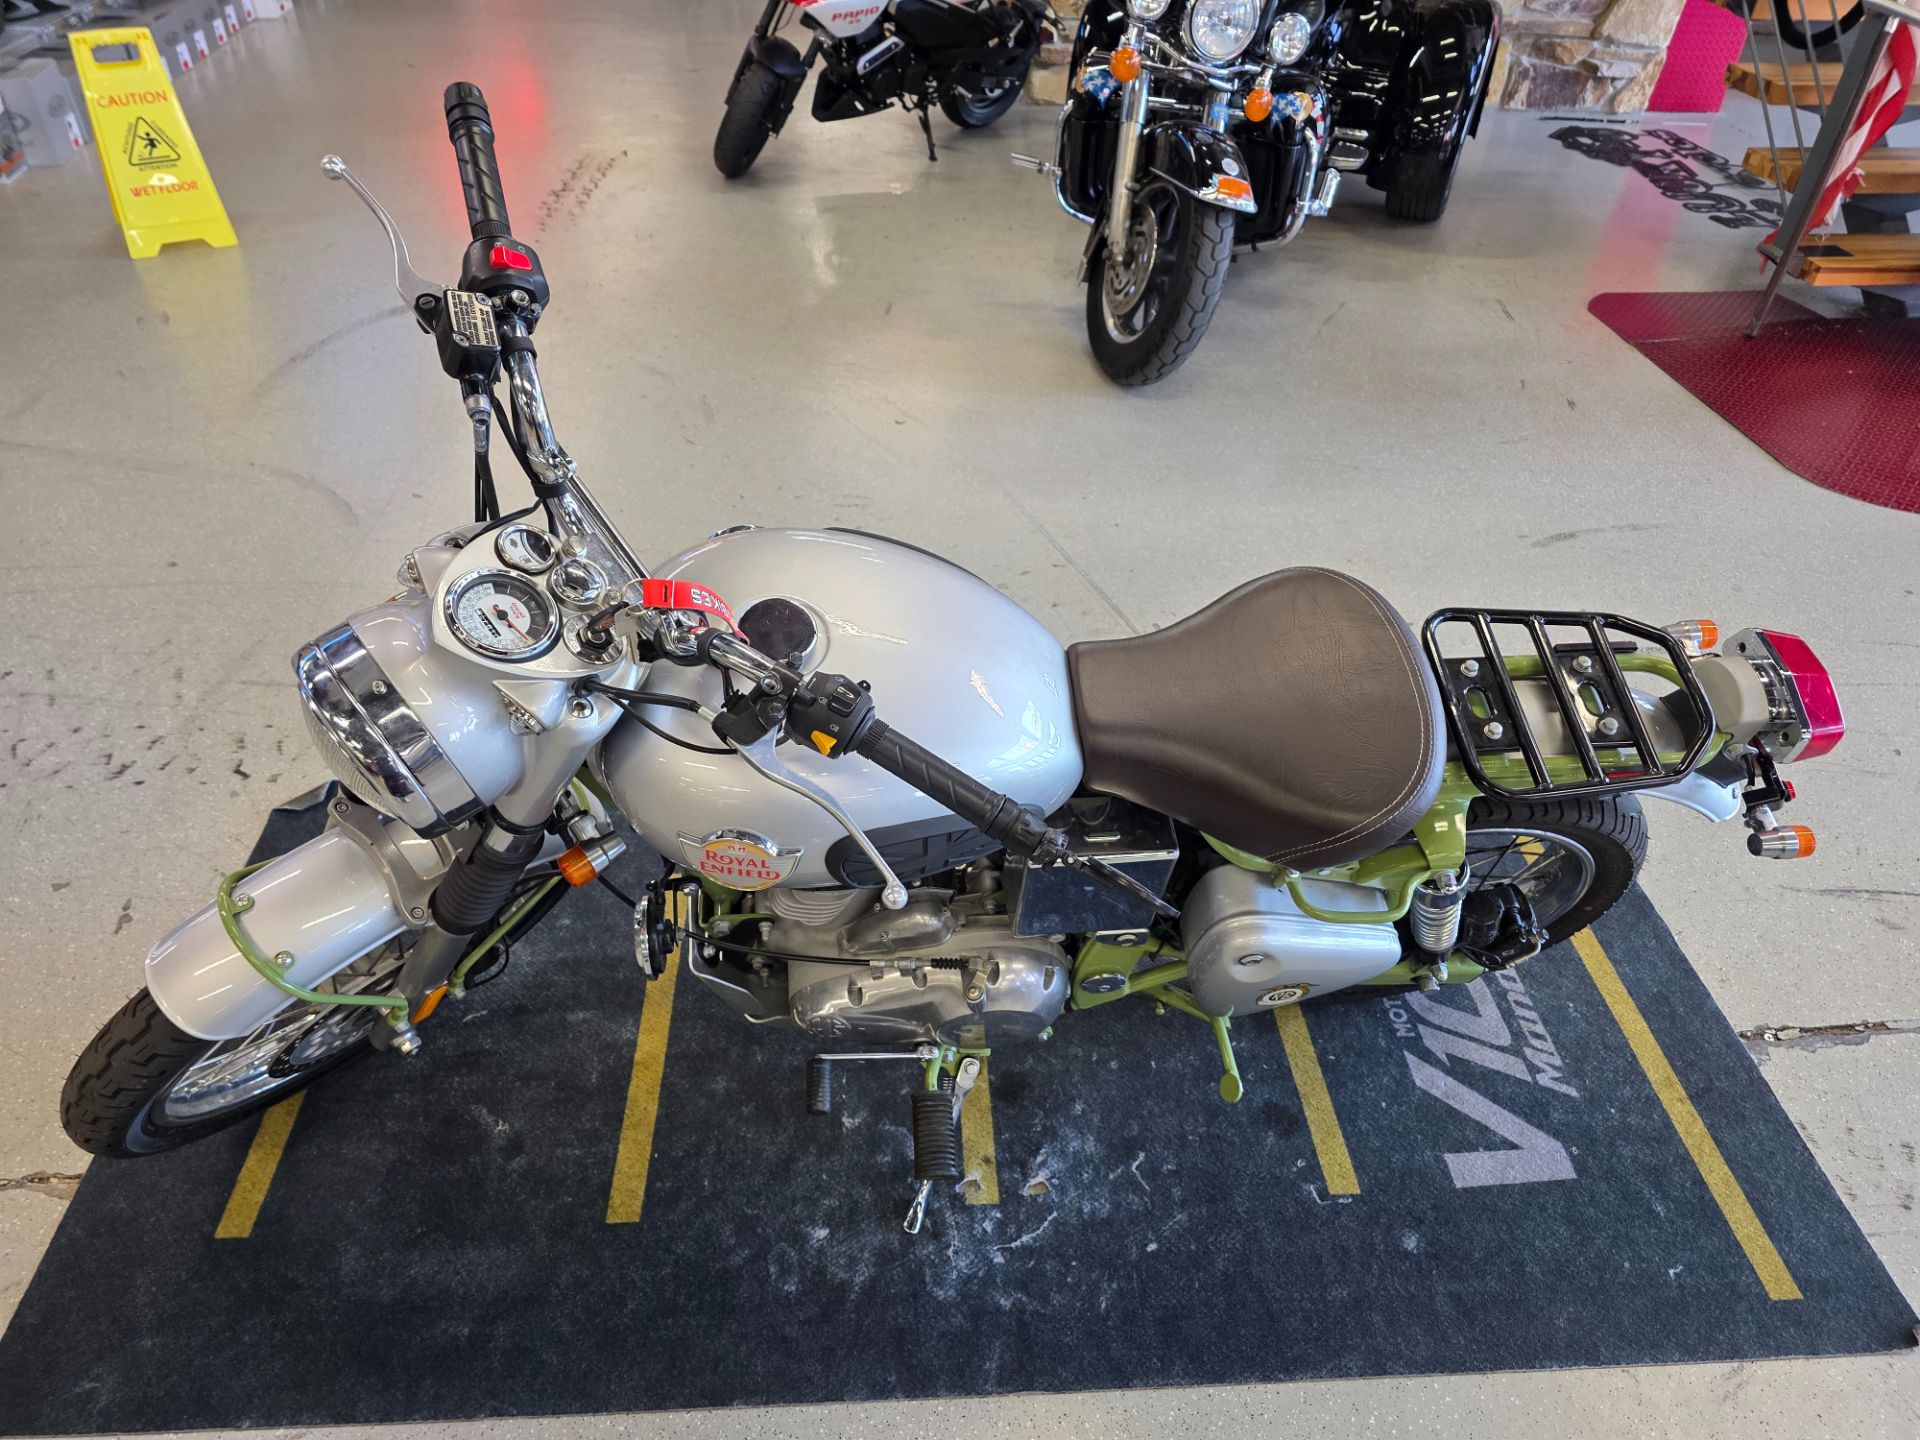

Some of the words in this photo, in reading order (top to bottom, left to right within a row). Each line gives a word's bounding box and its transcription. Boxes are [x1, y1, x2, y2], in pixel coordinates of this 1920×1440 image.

[831, 6, 880, 22] PAPIO
[96, 90, 169, 109] CAUTION
[130, 185, 158, 198] WET
[705, 849, 771, 869] ROYAL
[699, 861, 781, 881] ENFIELD
[1383, 997, 1416, 1037] MOT
